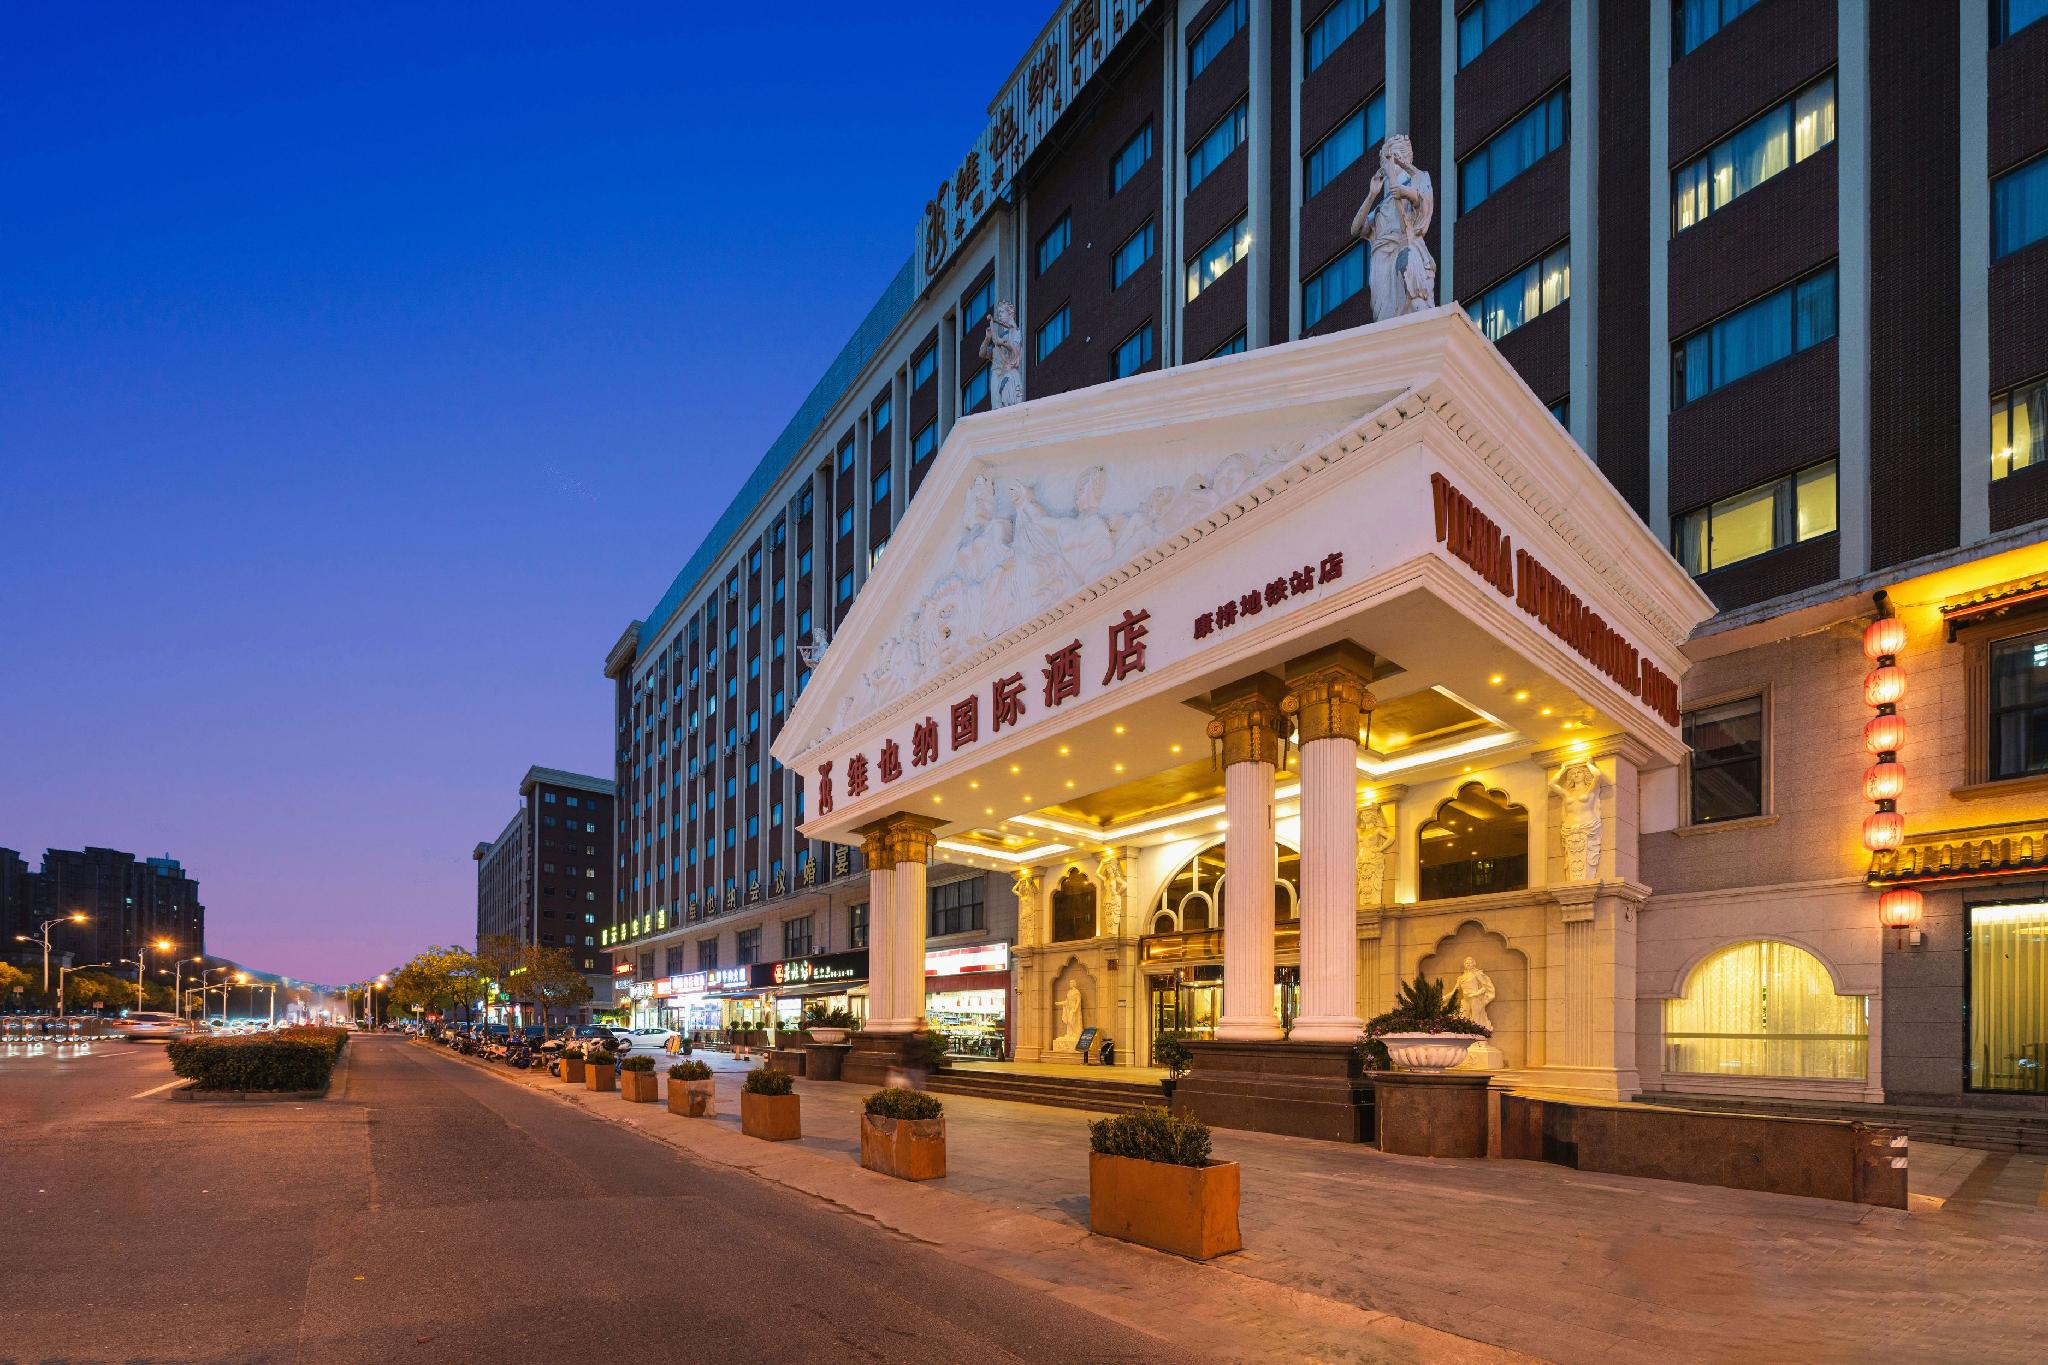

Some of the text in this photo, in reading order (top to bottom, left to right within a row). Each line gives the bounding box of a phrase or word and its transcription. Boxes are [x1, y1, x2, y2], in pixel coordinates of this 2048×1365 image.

[1193, 552, 1344, 641] 康桥地铁站店
[1431, 472, 1680, 727] VIENNA INTERNATIONAL HOTEL
[847, 607, 1151, 797] 维也纳国际酒店
[689, 846, 849, 920] 维也纳会议婚宴
